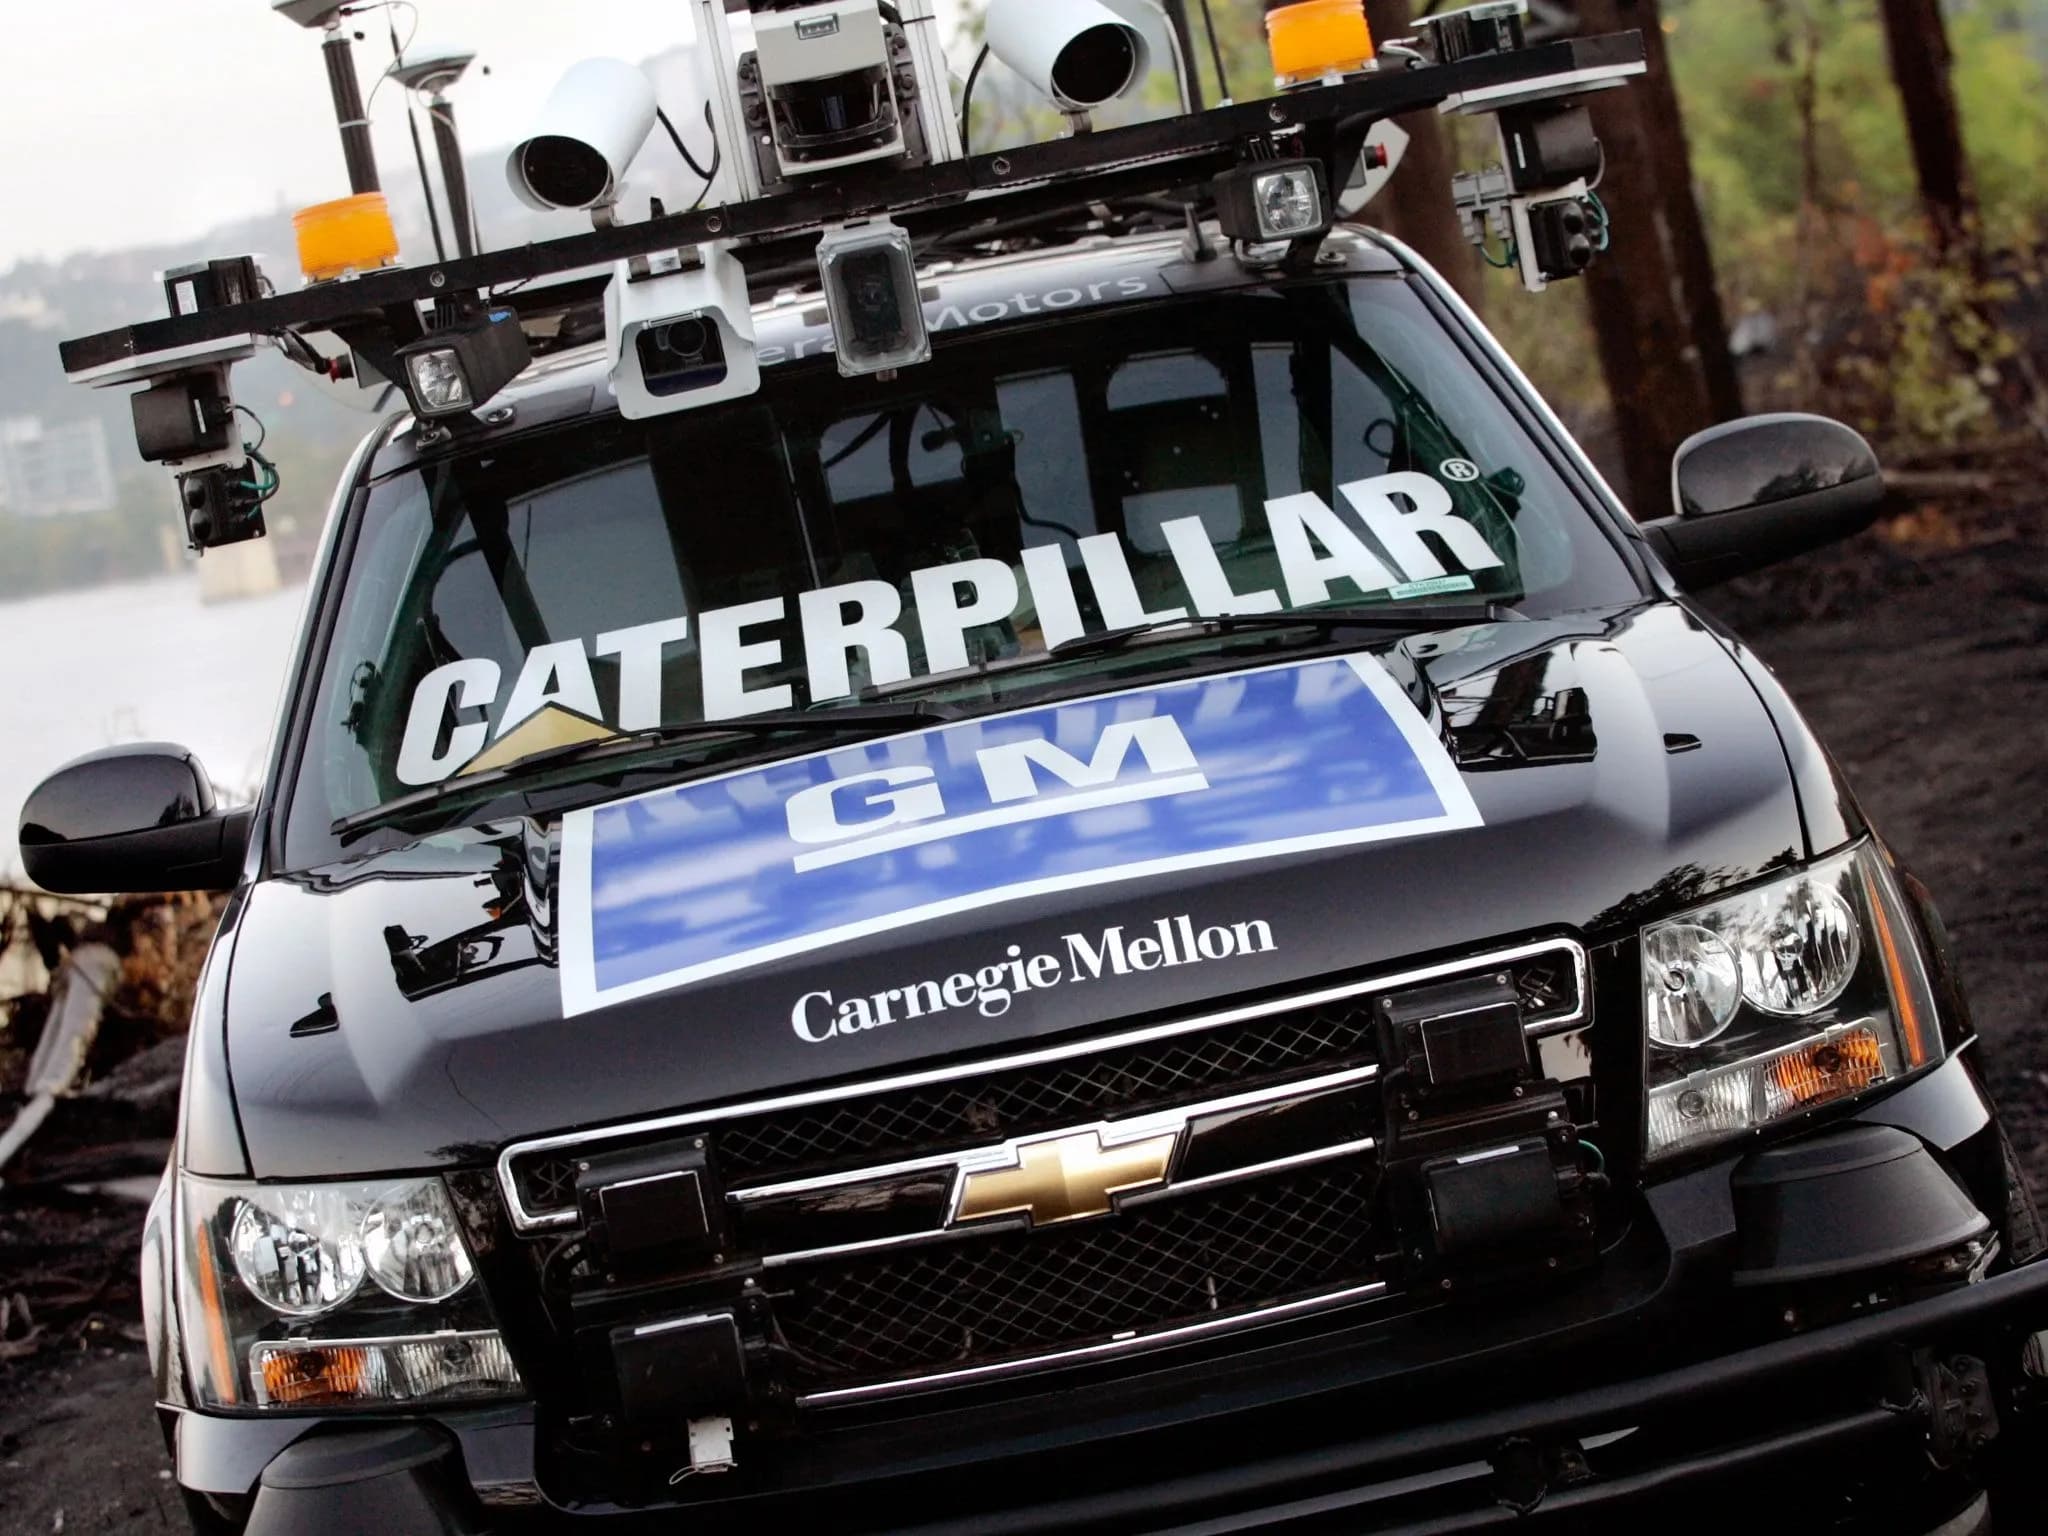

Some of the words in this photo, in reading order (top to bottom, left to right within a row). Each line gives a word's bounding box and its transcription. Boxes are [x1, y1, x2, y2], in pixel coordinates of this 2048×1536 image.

[785, 714, 1199, 845] GM
[790, 944, 1062, 1044] Carnegie
[1061, 914, 1278, 984] Mellon
